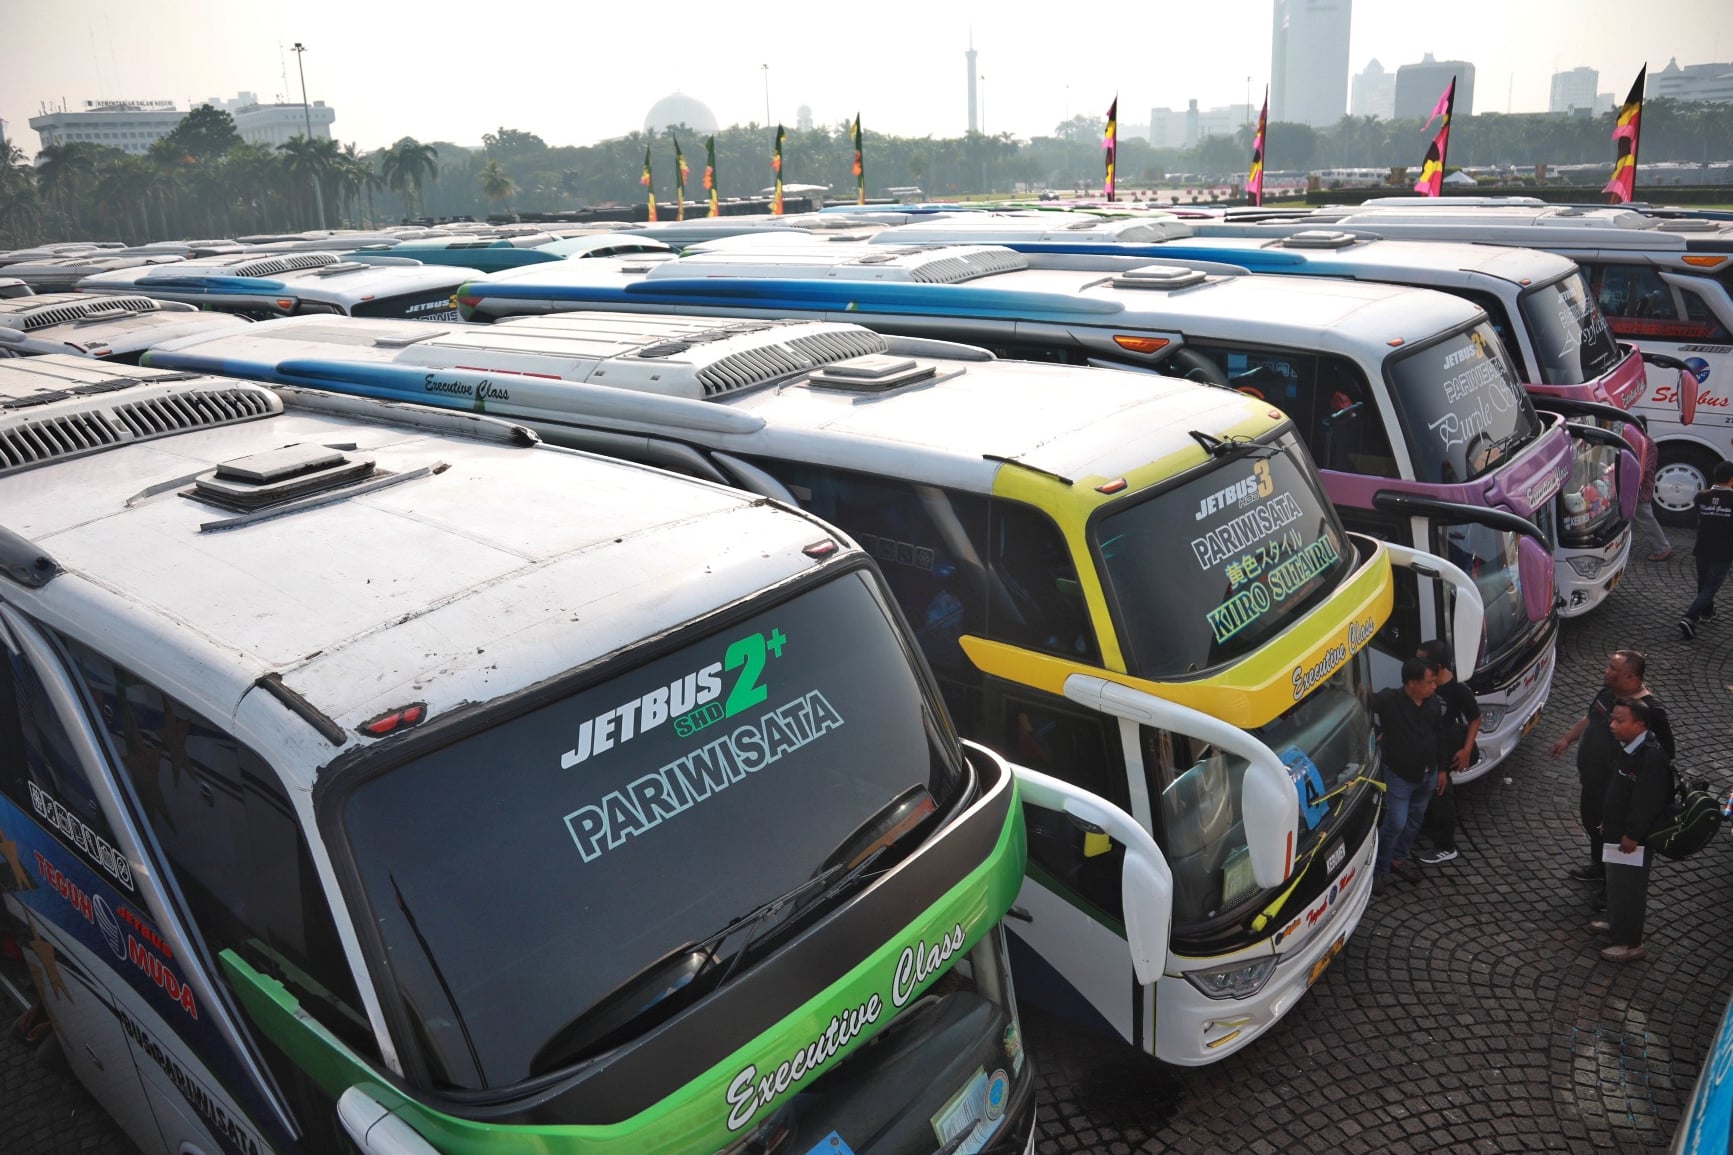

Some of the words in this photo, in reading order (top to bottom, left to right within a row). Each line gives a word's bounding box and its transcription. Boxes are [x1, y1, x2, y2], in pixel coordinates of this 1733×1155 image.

[405, 299, 450, 313] JETBUS
[1443, 344, 1476, 370] JETBUS
[1678, 344, 1732, 354] JETBUS
[424, 373, 473, 396] Executive
[476, 379, 510, 400] Class
[1652, 386, 1729, 408] Stbus
[1428, 396, 1493, 453] Purple
[1195, 475, 1258, 521] JETBUS
[1253, 457, 1275, 498] 3
[1191, 492, 1303, 571] PARIWISATA
[1225, 528, 1303, 590] 黄色スタイル
[1206, 581, 1271, 646] KIIRO
[1267, 534, 1339, 601] SUTAIRU
[1292, 642, 1347, 701] Executive
[1347, 616, 1376, 656] Class
[560, 660, 723, 770] JETBUS
[673, 700, 726, 739] SHD
[563, 689, 845, 864] PARIWISATA
[33, 849, 95, 925] TEGUH
[128, 934, 199, 1021] MUDA
[726, 993, 883, 1131] Executive
[891, 922, 967, 1008] Class
